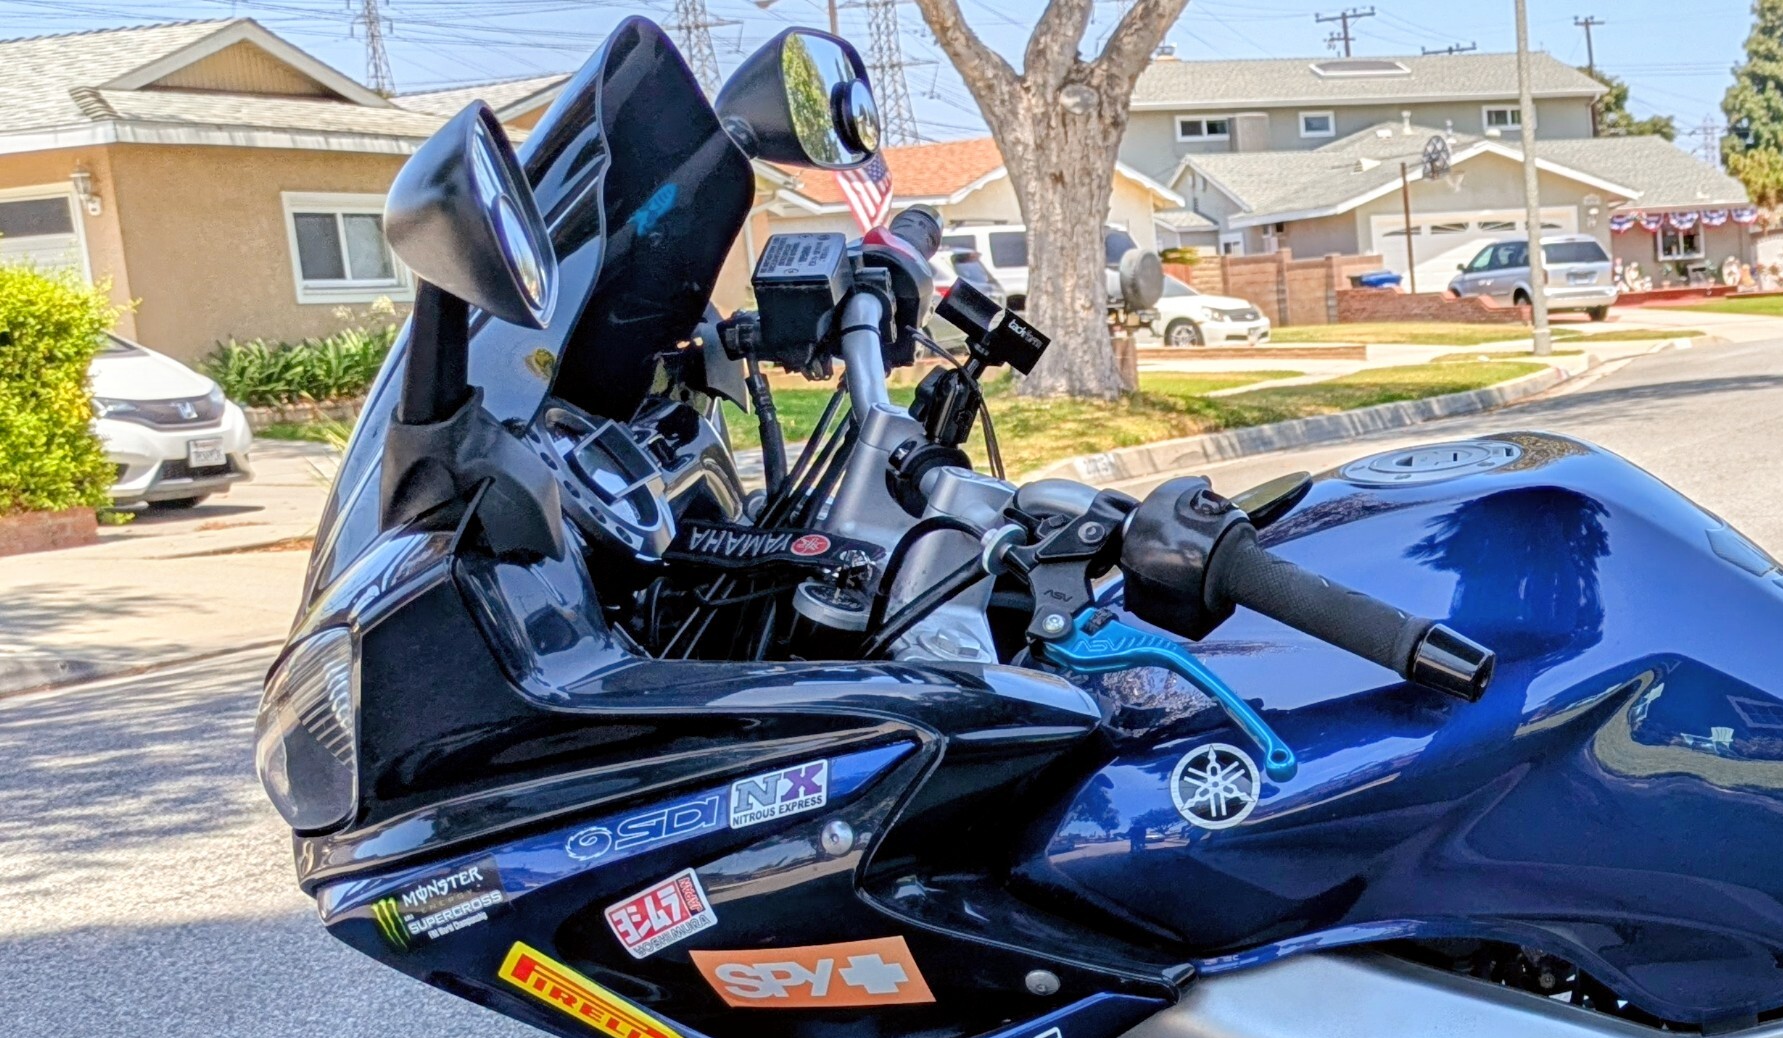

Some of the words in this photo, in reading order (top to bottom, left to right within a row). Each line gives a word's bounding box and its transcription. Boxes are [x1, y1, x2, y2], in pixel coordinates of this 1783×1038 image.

[688, 526, 793, 557] YAMAHA
[732, 762, 824, 815] NX
[732, 805, 776, 827] NITROUS
[778, 795, 823, 814] EXPRESS
[407, 889, 504, 935] SUPERCROSS
[633, 914, 711, 956] YOSHIMURA
